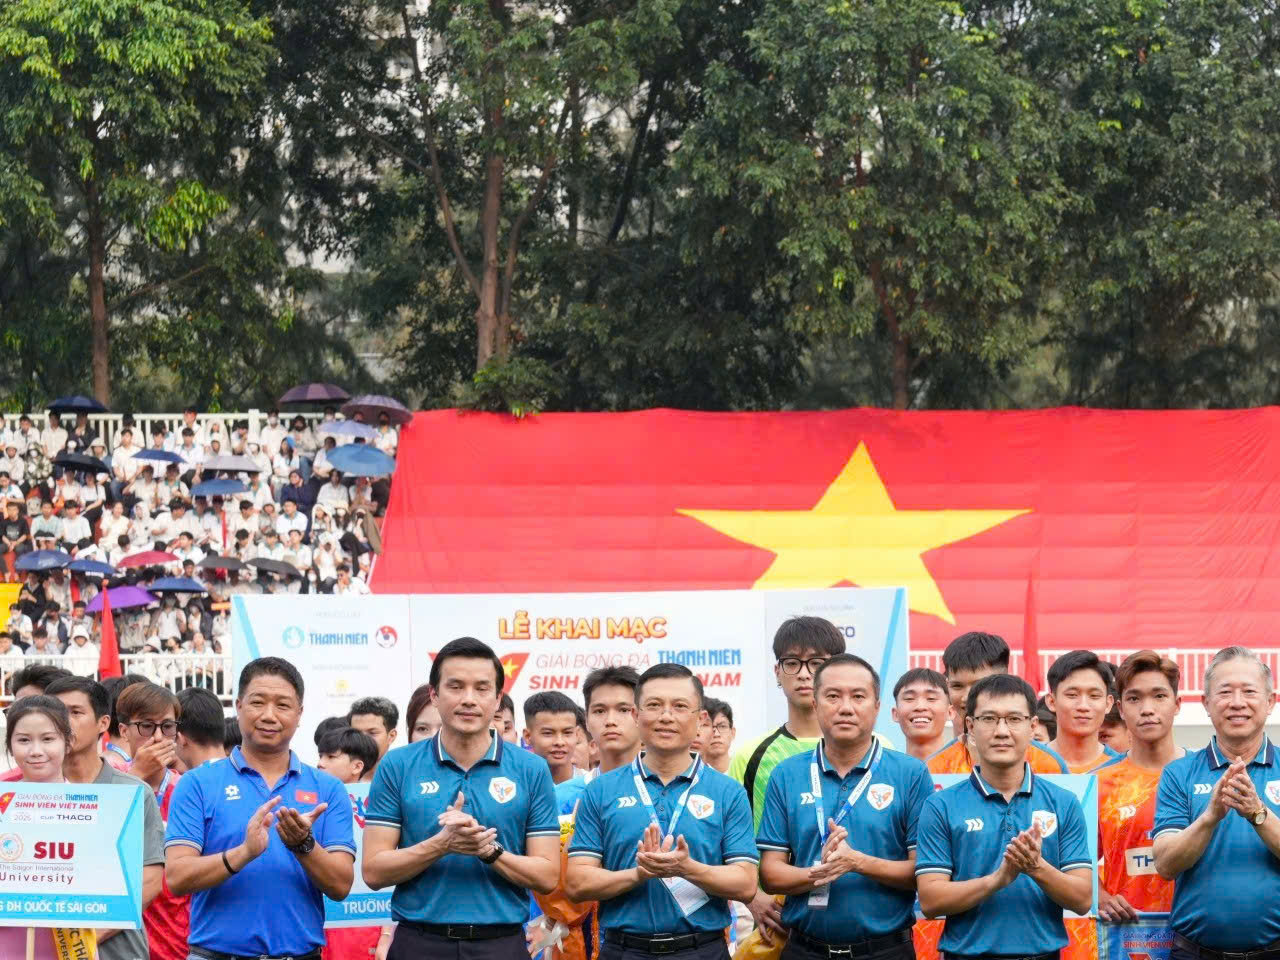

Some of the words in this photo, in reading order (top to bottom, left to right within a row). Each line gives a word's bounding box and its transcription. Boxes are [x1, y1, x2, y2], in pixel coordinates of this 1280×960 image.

[499, 610, 531, 640] LỄ
[536, 617, 600, 640] KHAI
[606, 617, 667, 644] MẠC
[657, 650, 706, 666] THANH
[529, 675, 580, 690] SINH
[695, 672, 742, 687] NAM
[34, 842, 74, 859] SIU
[0, 873, 73, 885] University
